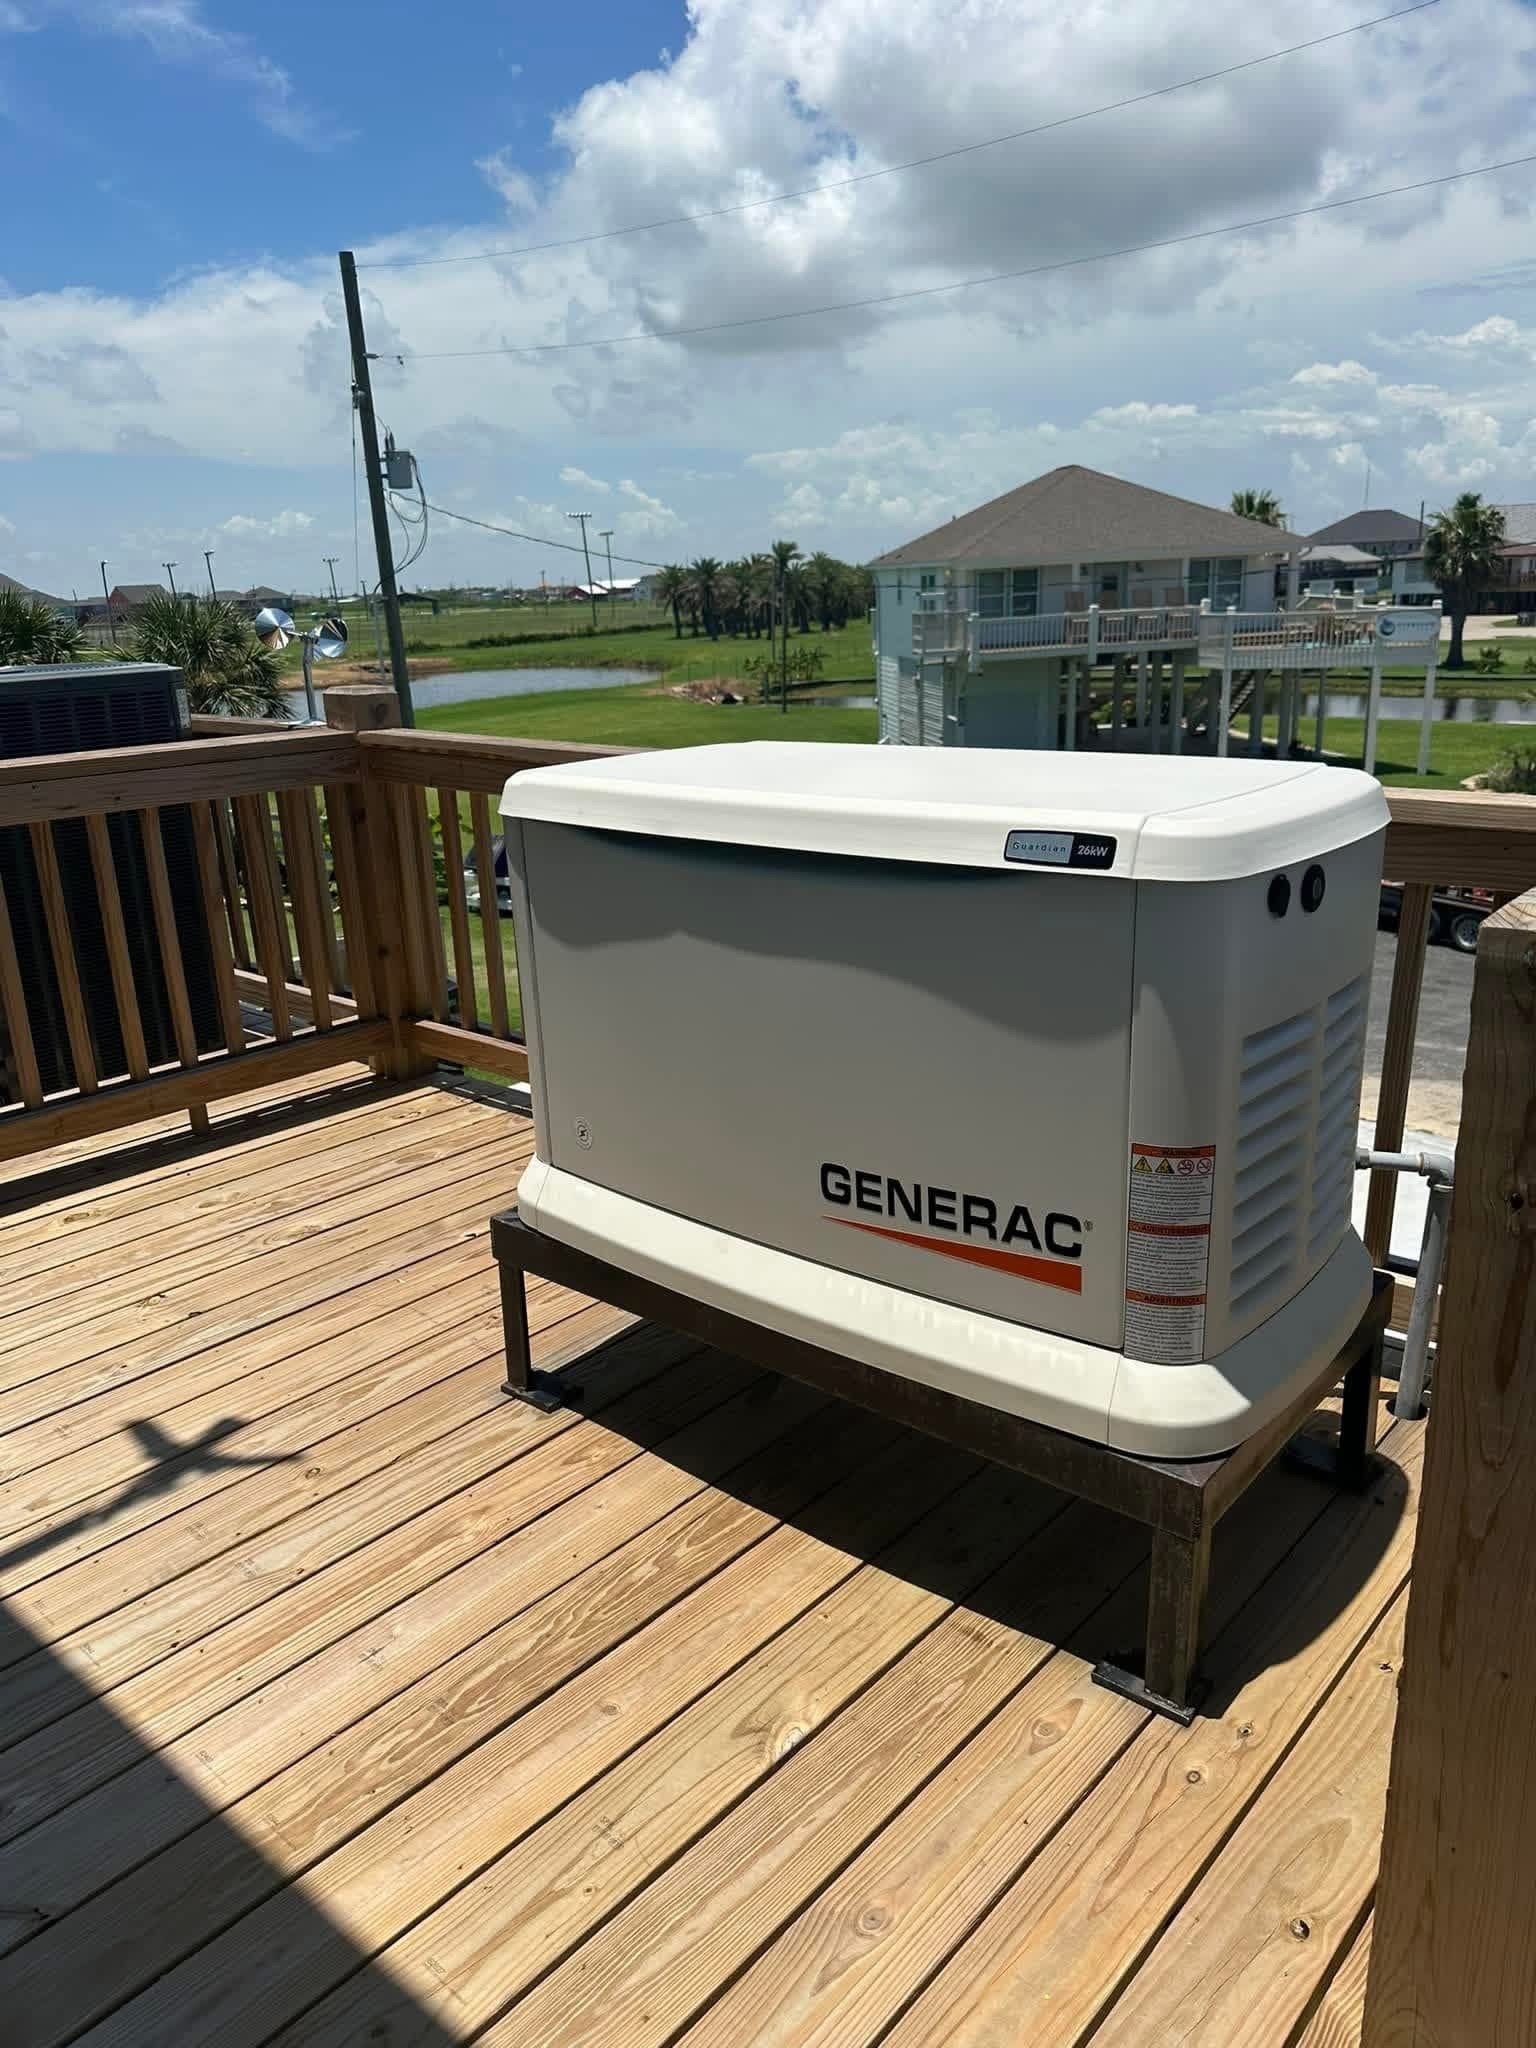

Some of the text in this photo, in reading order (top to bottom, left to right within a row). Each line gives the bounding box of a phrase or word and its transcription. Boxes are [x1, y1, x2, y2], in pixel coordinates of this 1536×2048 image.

[1012, 841, 1108, 857] Guardian 26kW
[820, 1162, 1083, 1258] GENERAC
